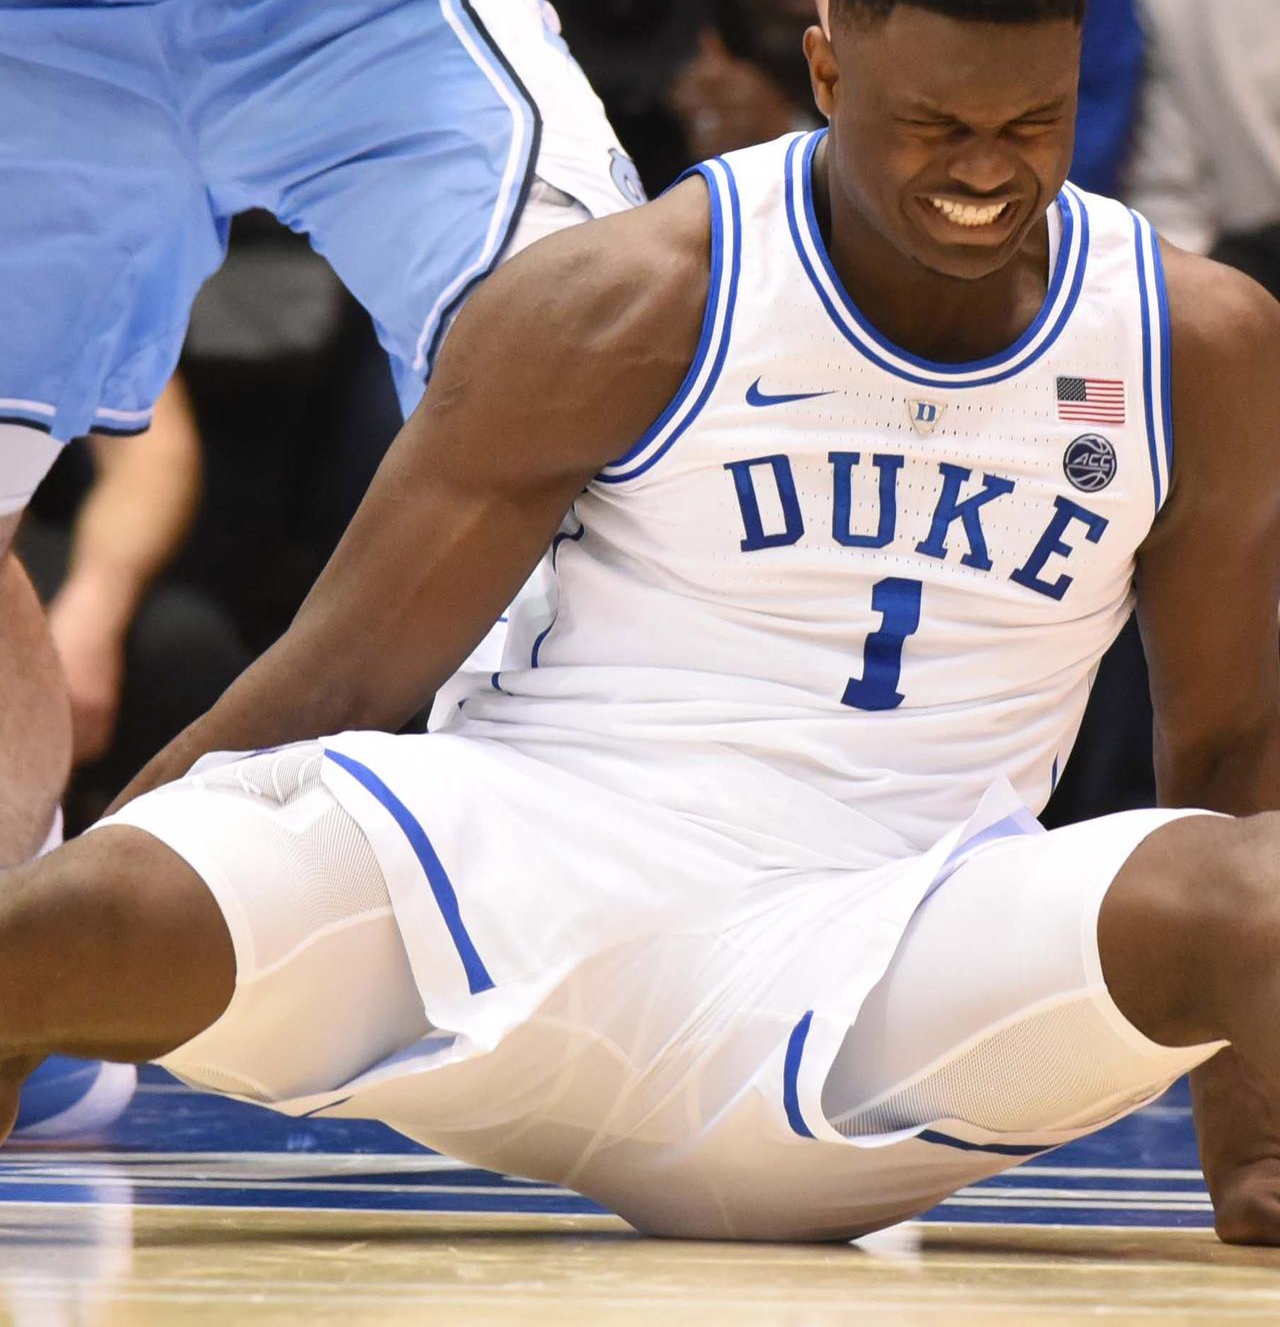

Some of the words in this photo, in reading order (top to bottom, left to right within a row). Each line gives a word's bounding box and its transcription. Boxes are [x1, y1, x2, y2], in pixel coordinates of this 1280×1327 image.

[916, 402, 936, 422] D
[1073, 452, 1113, 467] ACC
[723, 451, 1110, 602] DUKE
[840, 576, 923, 711] 1
